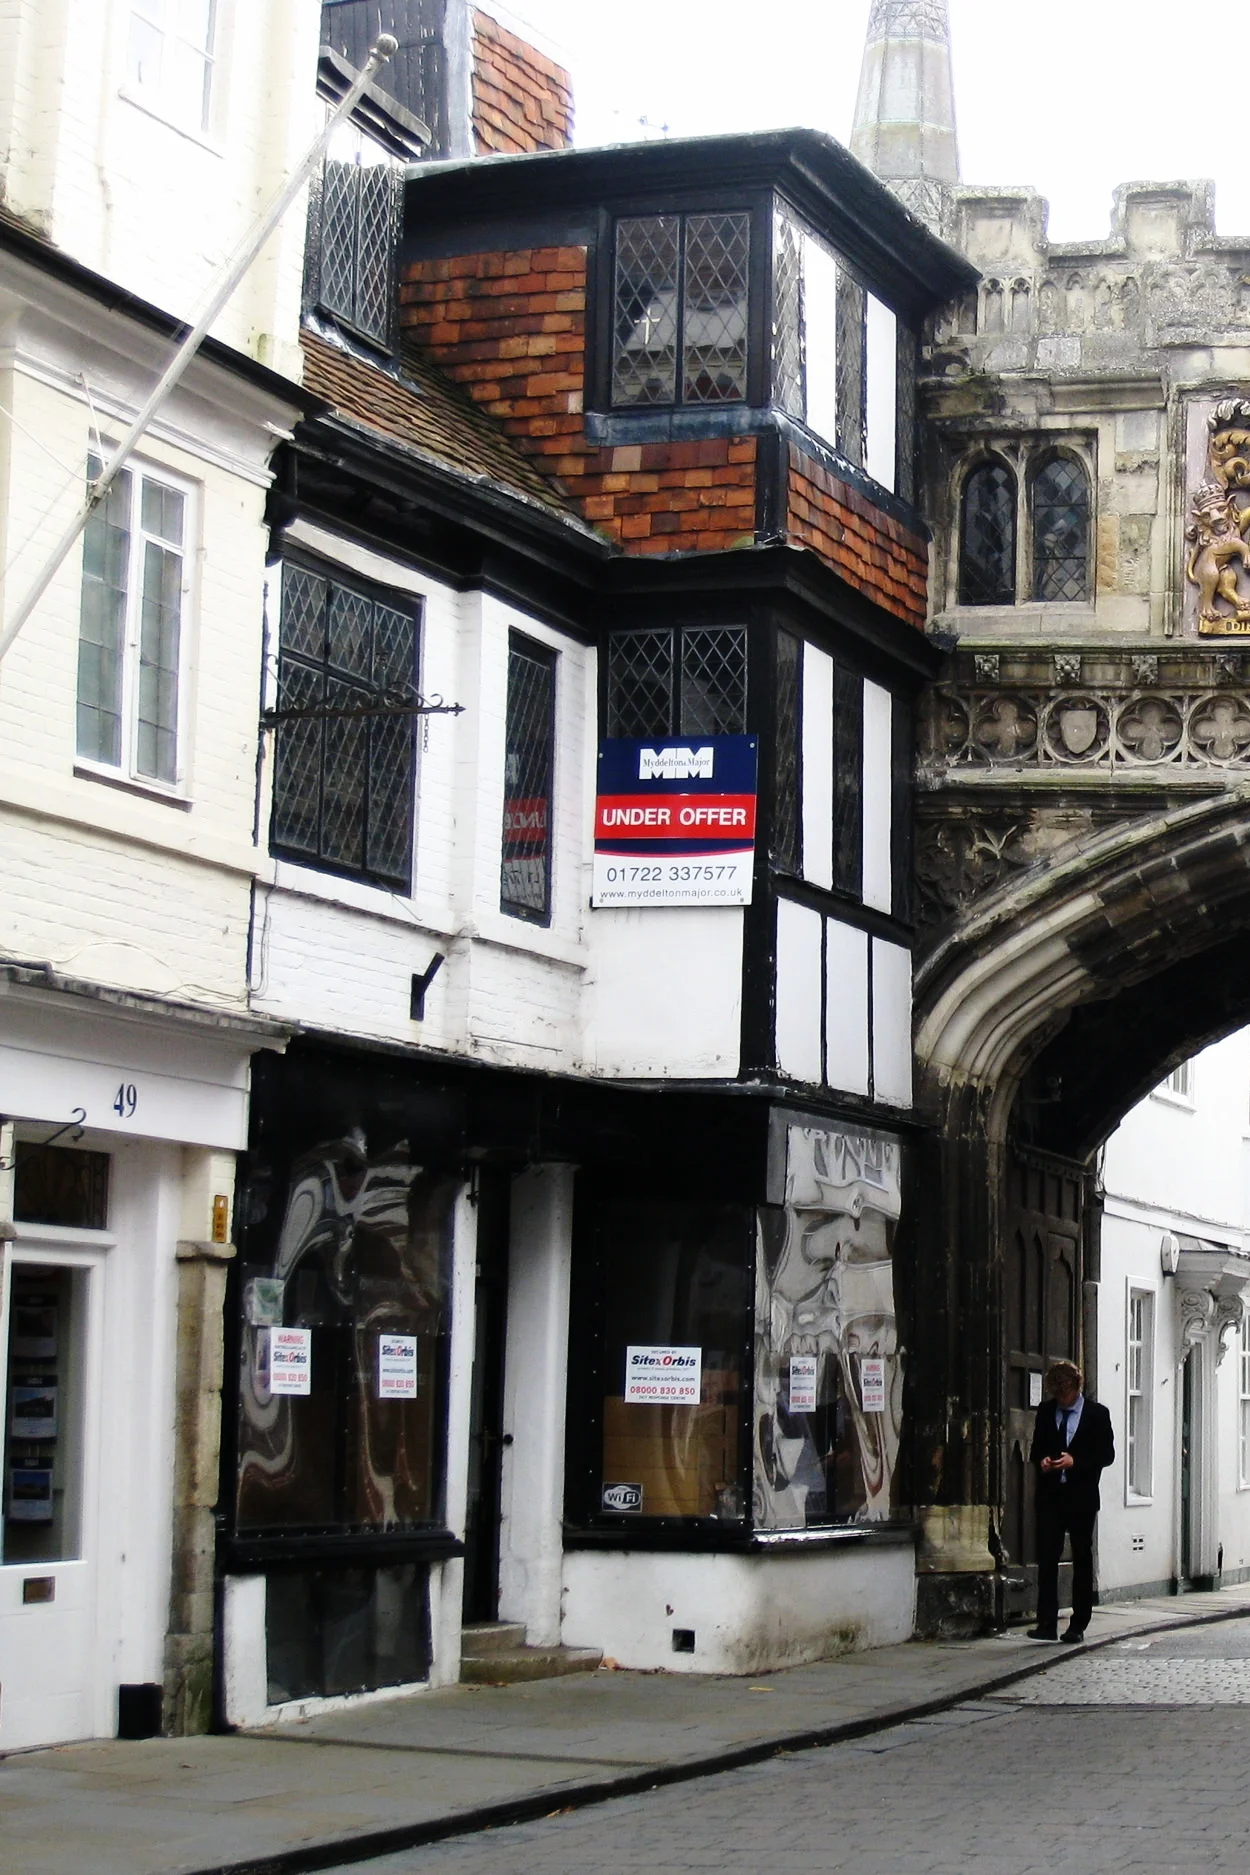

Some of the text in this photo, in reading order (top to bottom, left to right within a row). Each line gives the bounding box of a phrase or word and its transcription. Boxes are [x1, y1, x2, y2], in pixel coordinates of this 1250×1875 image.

[602, 807, 746, 826] UNDER OFFER
[606, 866, 737, 882] 01722 337577
[600, 887, 742, 899] www.myddeltonmajor.co.uk
[113, 1083, 137, 1118] 49
[630, 1386, 657, 1394] 08000
[679, 1387, 695, 1395] 850
